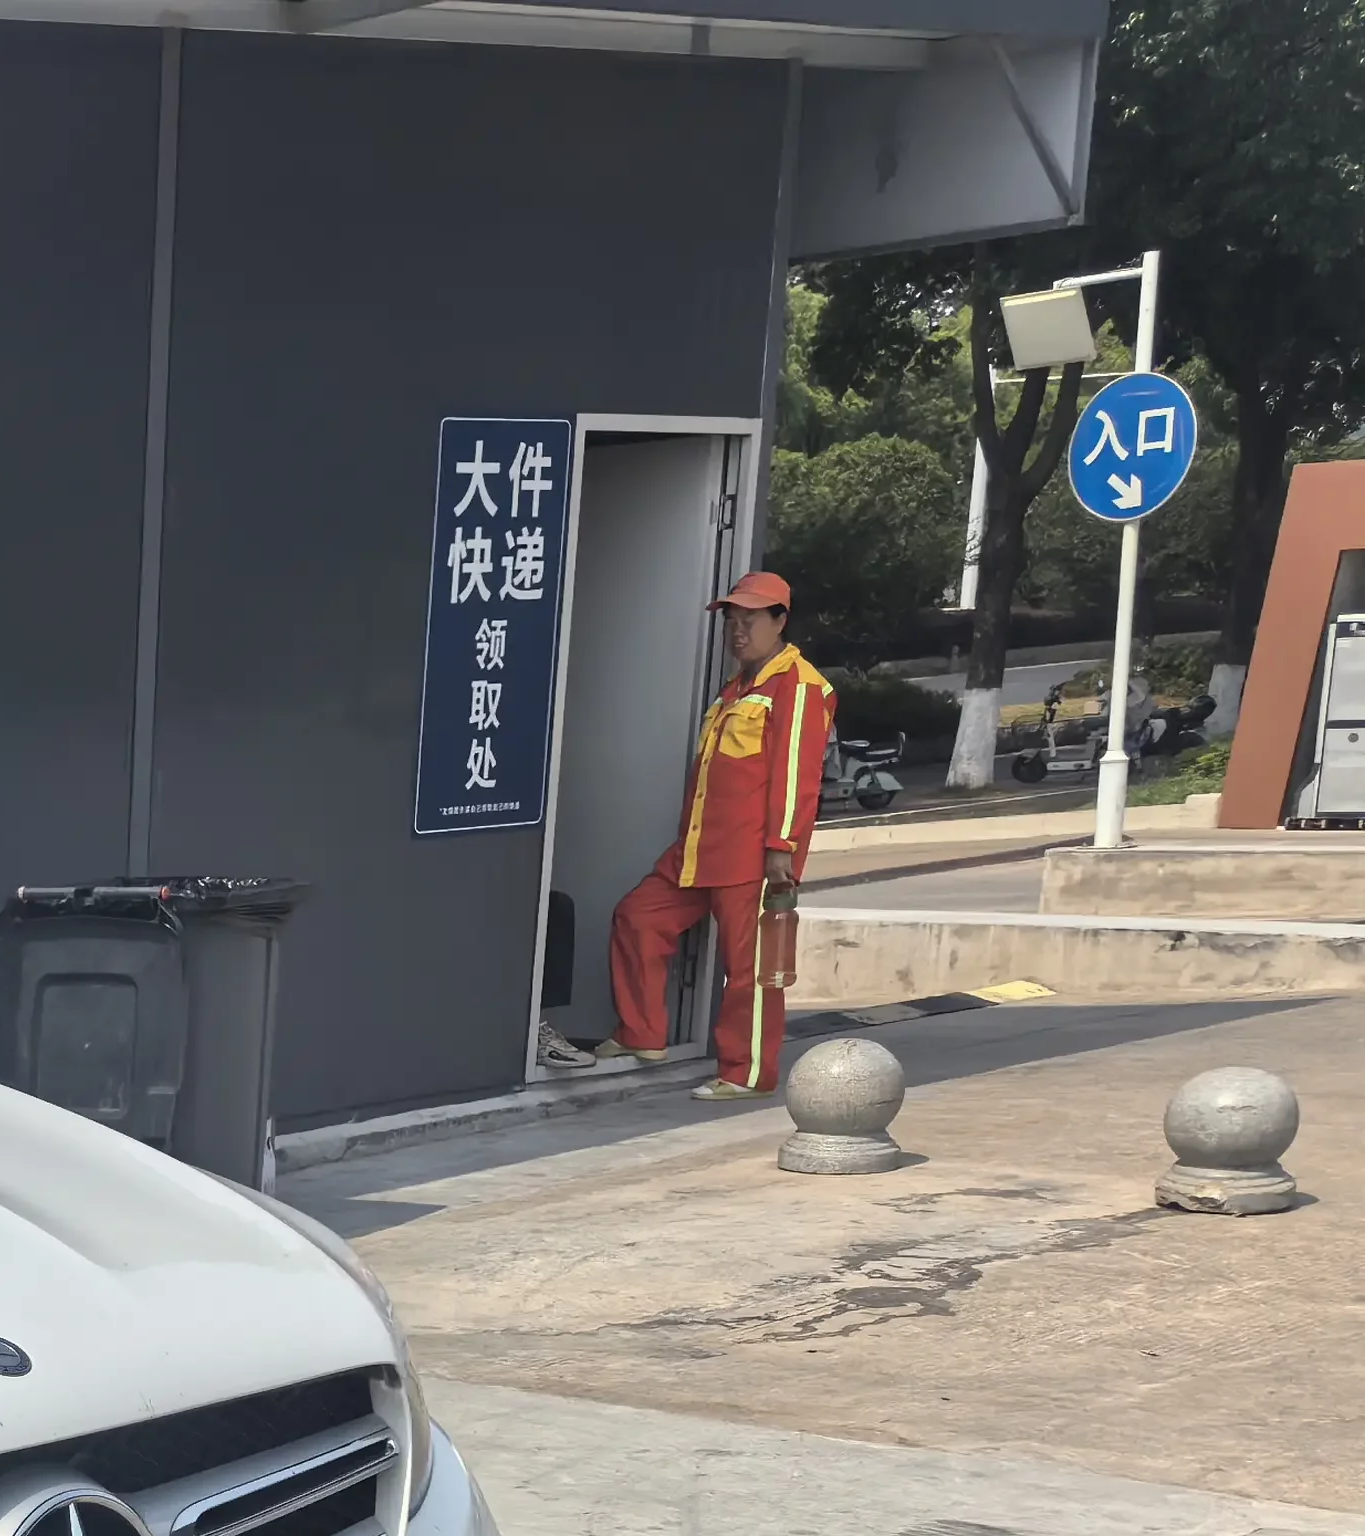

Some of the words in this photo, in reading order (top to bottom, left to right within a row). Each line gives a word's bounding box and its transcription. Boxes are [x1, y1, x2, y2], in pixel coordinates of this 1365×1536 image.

[1082, 406, 1176, 466] 入口
[453, 439, 553, 518] 大件
[447, 526, 545, 604] 快递
[465, 617, 508, 791] 领取处
